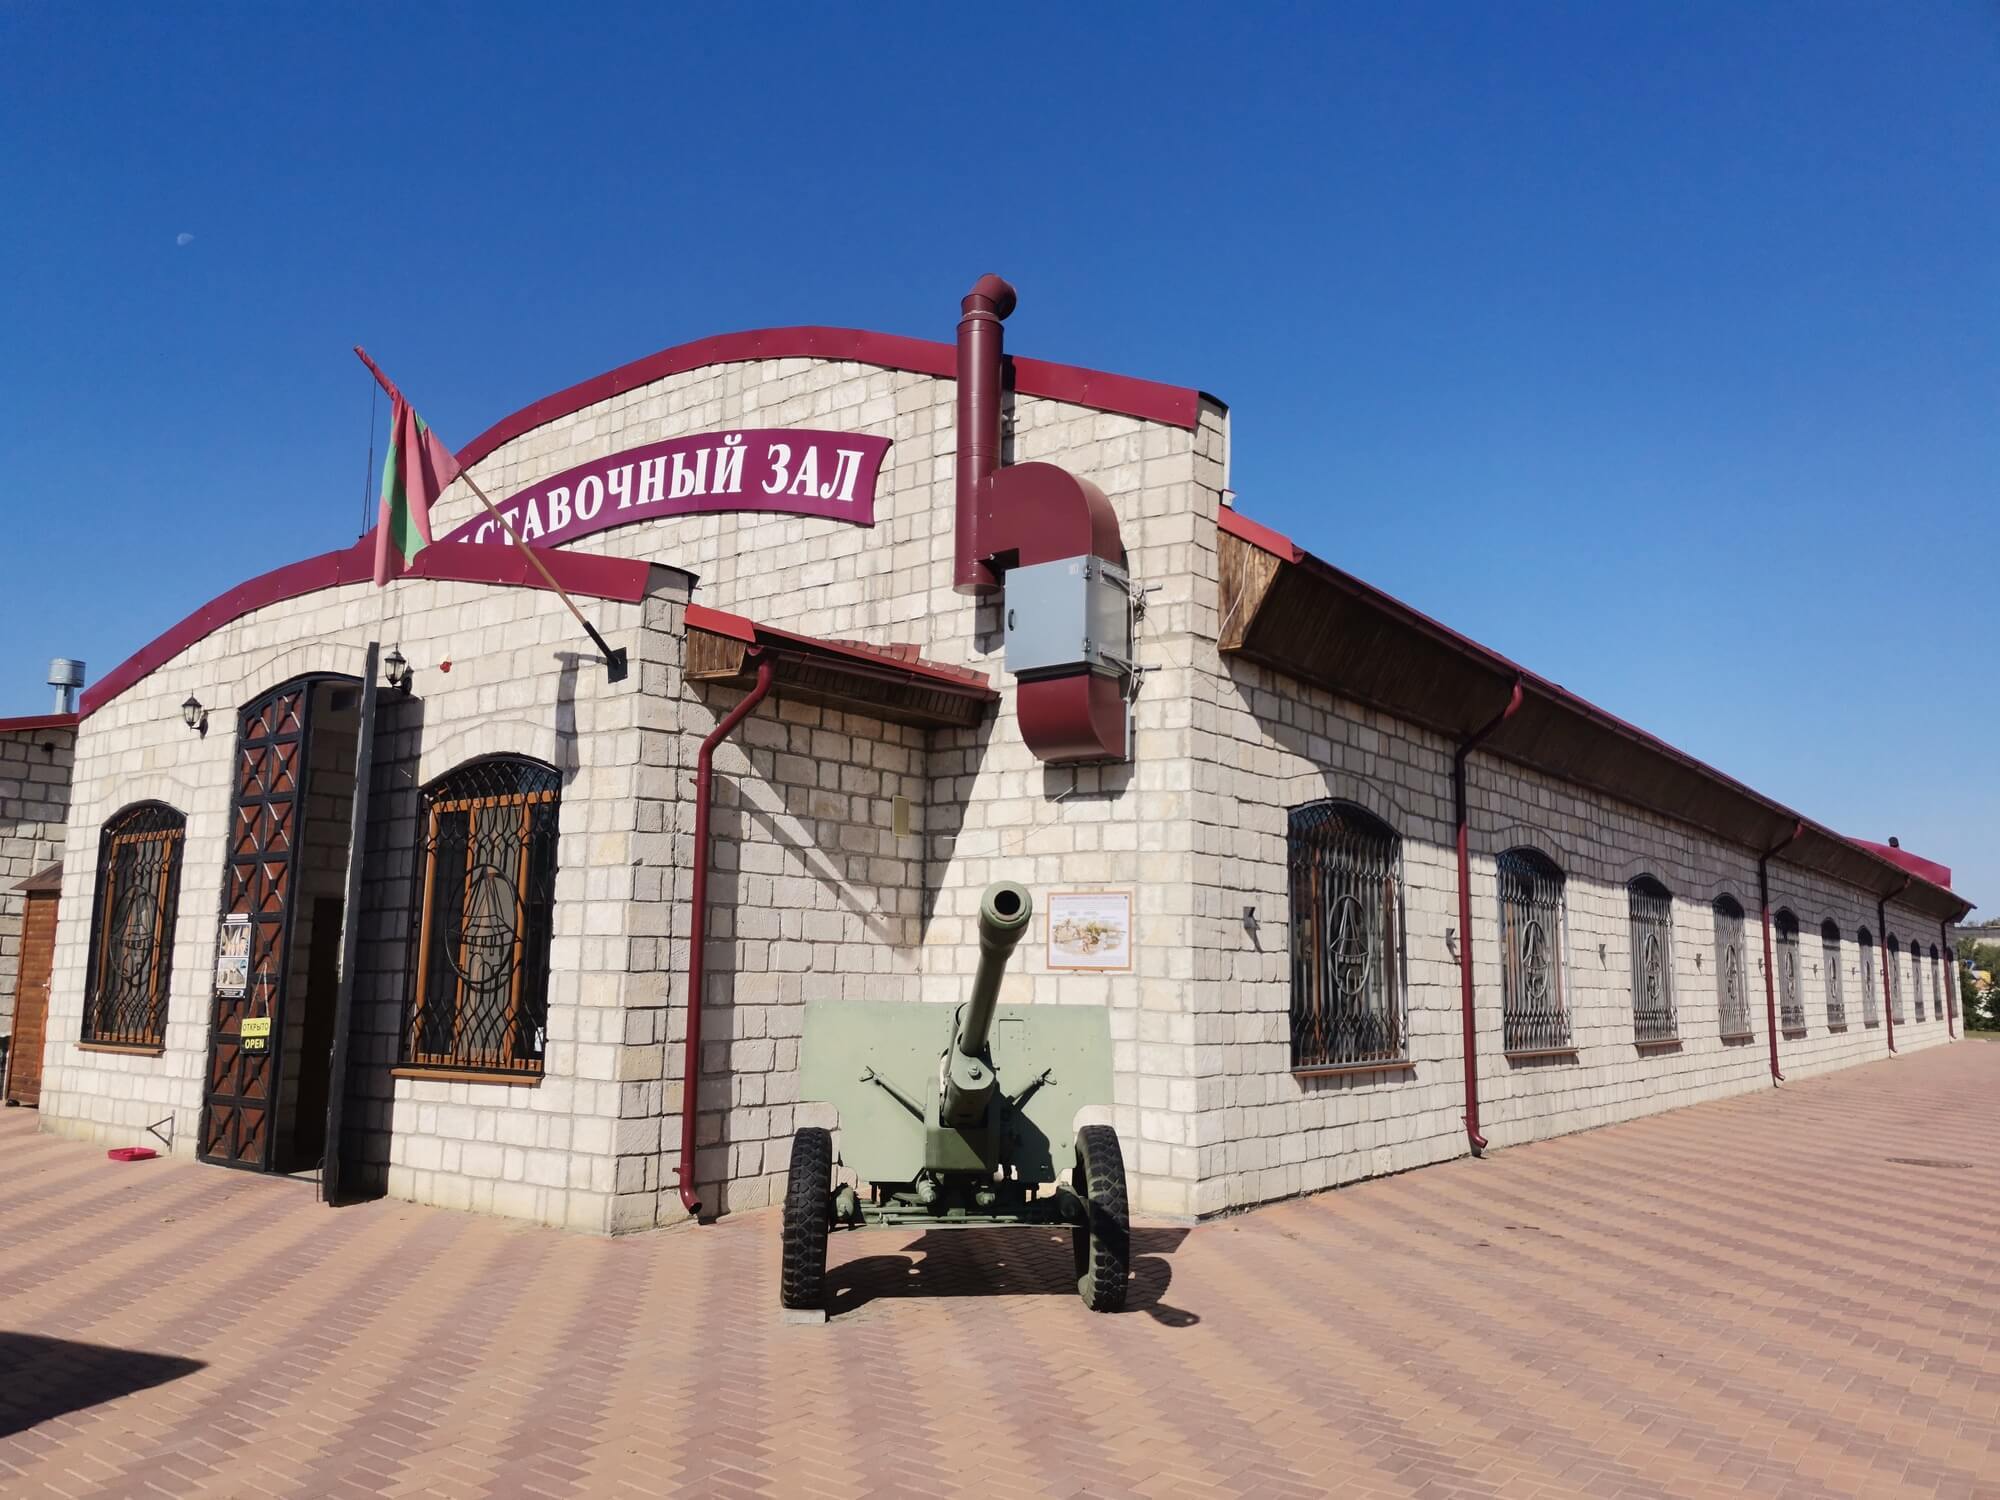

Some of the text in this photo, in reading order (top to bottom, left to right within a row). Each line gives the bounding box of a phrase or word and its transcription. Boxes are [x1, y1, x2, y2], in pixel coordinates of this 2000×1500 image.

[762, 443, 864, 501] ЗАЛ
[242, 1022, 269, 1032] ОТКРЫТО
[244, 1038, 265, 1049] OPEN
